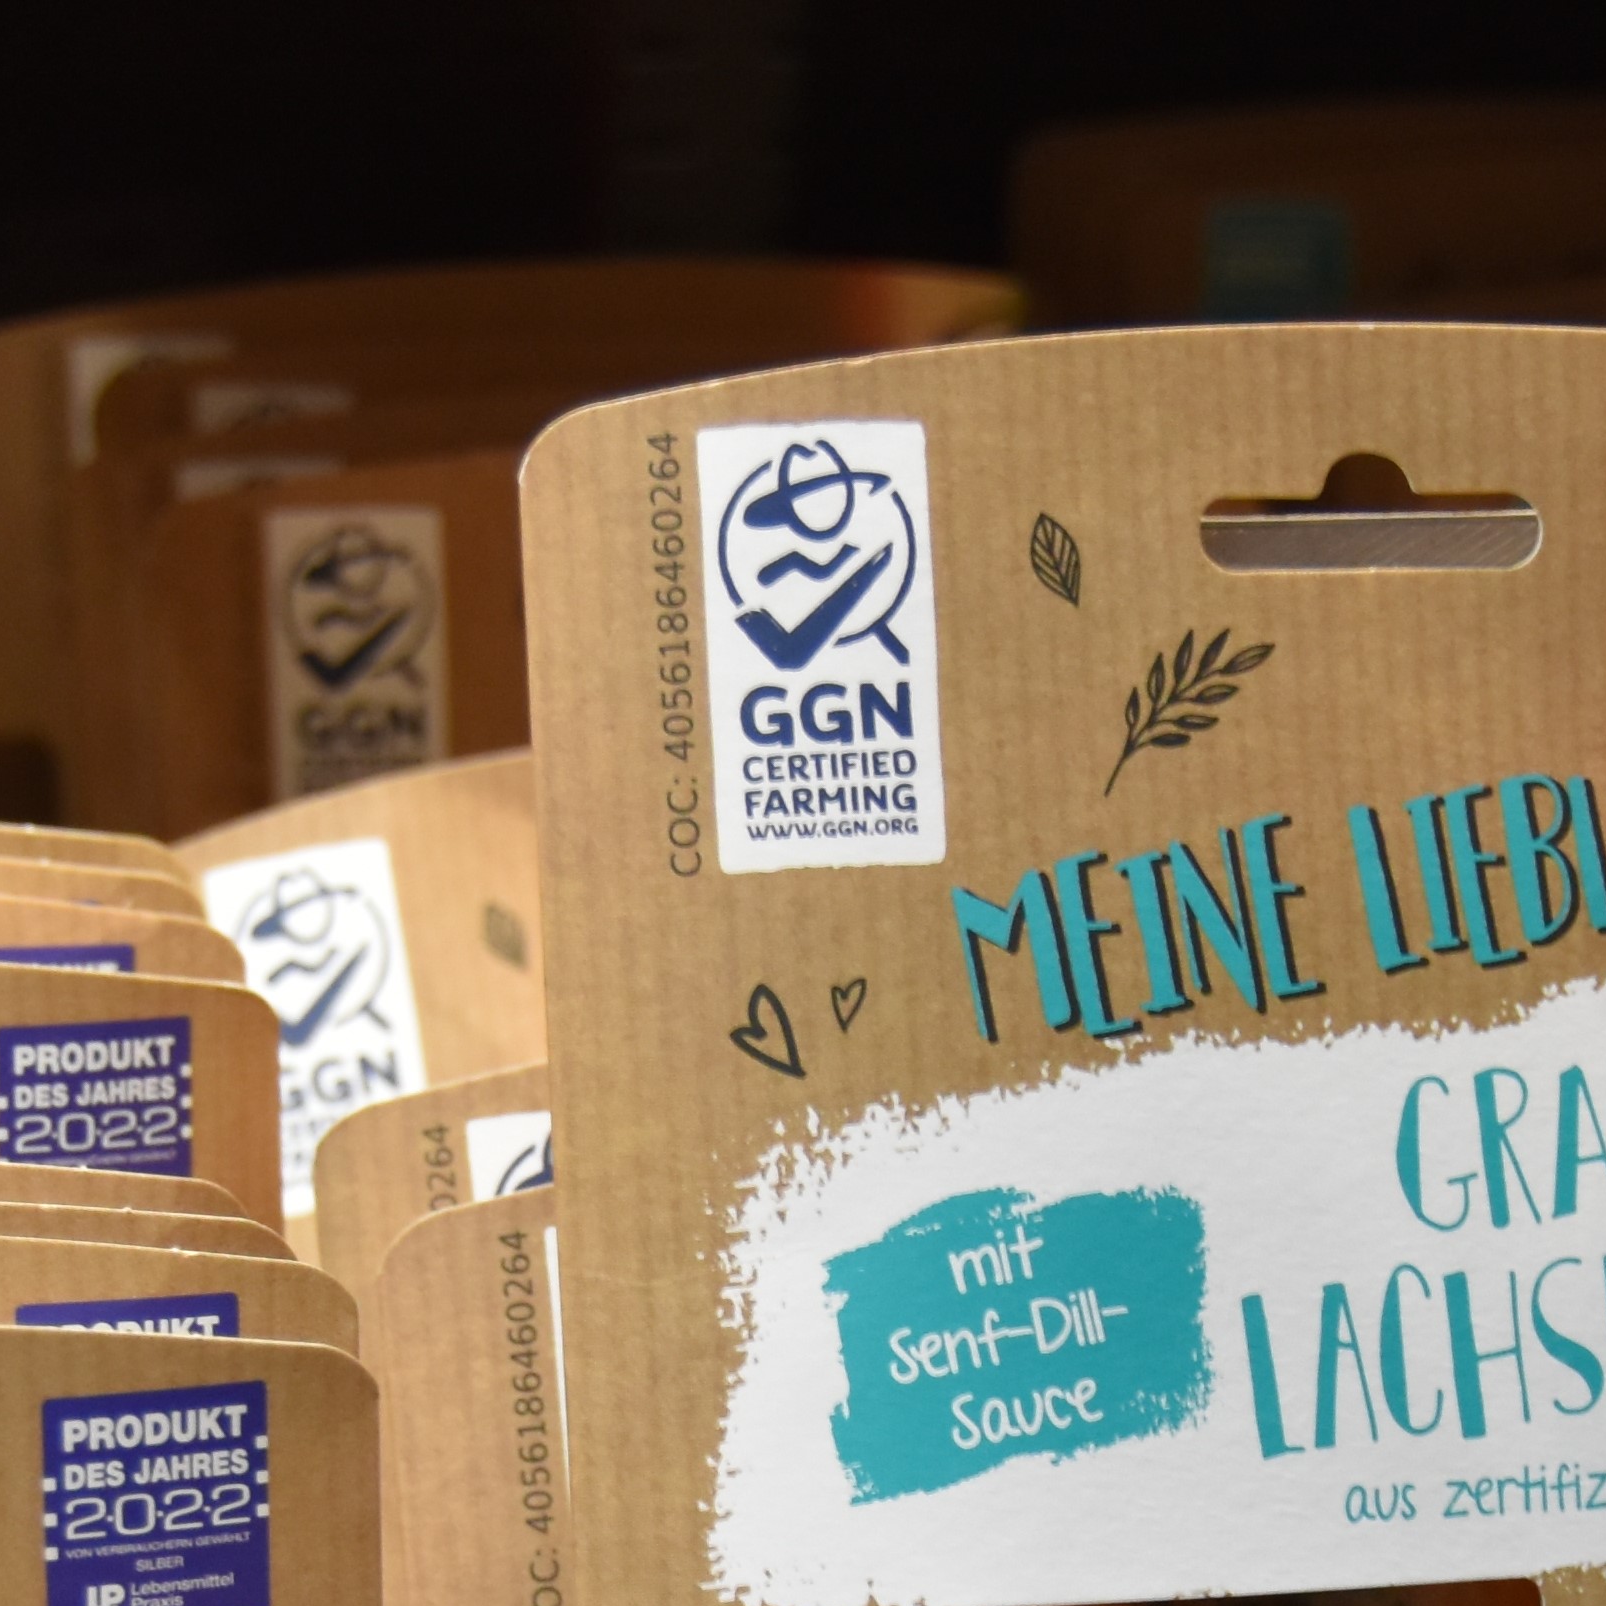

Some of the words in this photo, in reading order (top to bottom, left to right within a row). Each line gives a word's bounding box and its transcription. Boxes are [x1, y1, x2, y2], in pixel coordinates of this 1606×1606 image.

[648, 432, 695, 763] 4056186460264
[740, 681, 913, 748] GGN
[742, 749, 918, 783] CERTIFIED
[745, 783, 918, 818] FARMING
[665, 776, 701, 877] COC:
[747, 818, 919, 841] WWW.GGN.ORG
[950, 811, 1326, 1043] MEINE
[11, 1035, 175, 1076] PRODUKT
[12, 1083, 69, 1110] DES
[75, 1075, 176, 1107] JAHRES
[949, 1224, 1044, 1294] mit
[499, 1230, 555, 1535] 4056186460264
[62, 1404, 248, 1453] PRODUKT
[64, 1460, 125, 1491] DES
[134, 1449, 249, 1485] JAHRES
[1345, 1477, 1417, 1526] aus
[65, 1549, 92, 1559] VON
[136, 1556, 184, 1572] SILBER
[131, 1572, 234, 1596] Lebensmittel
